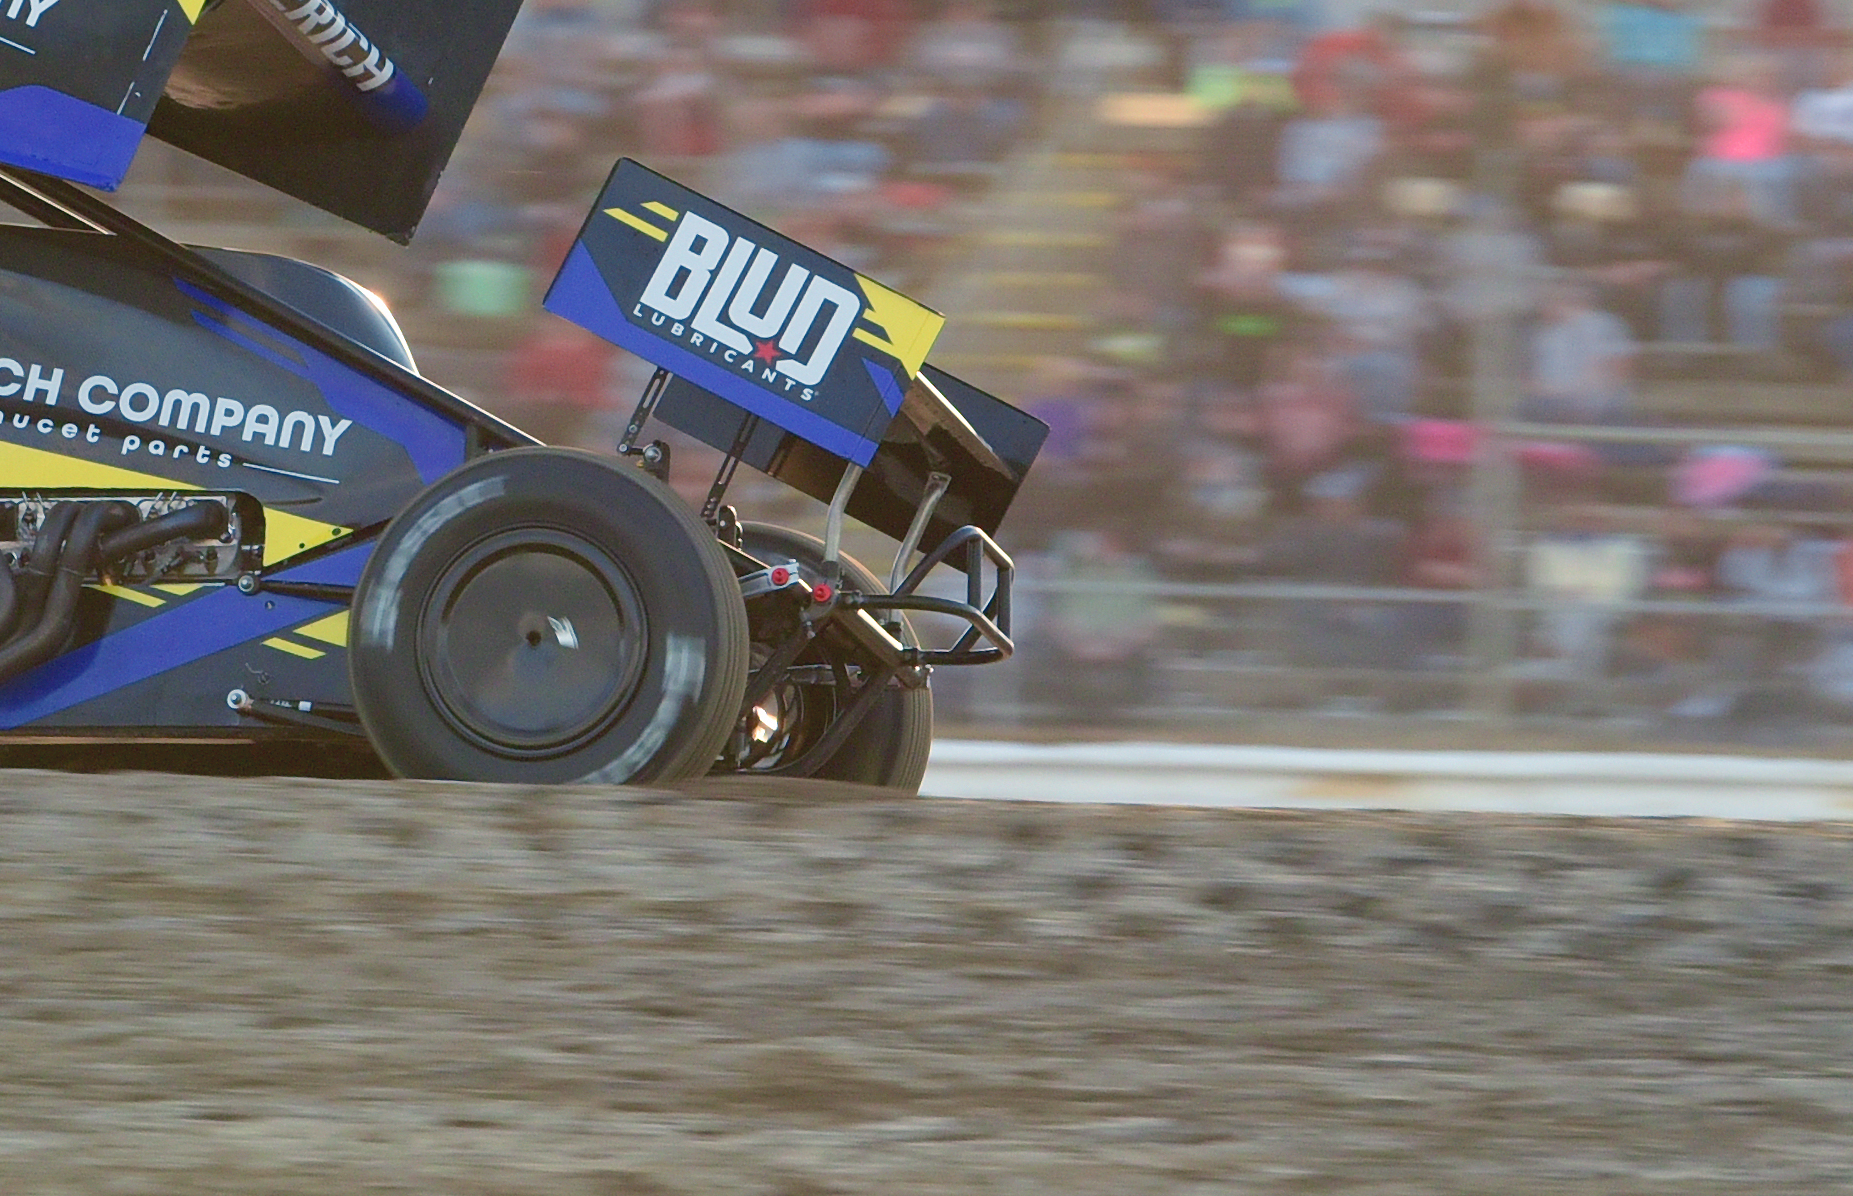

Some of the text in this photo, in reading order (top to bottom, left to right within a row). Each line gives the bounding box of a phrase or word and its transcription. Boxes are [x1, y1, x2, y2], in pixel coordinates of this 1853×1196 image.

[639, 210, 861, 386] BLUD
[632, 303, 815, 402] LUBRICANTS
[78, 375, 353, 456] COMPANY
[121, 433, 233, 469] parts
